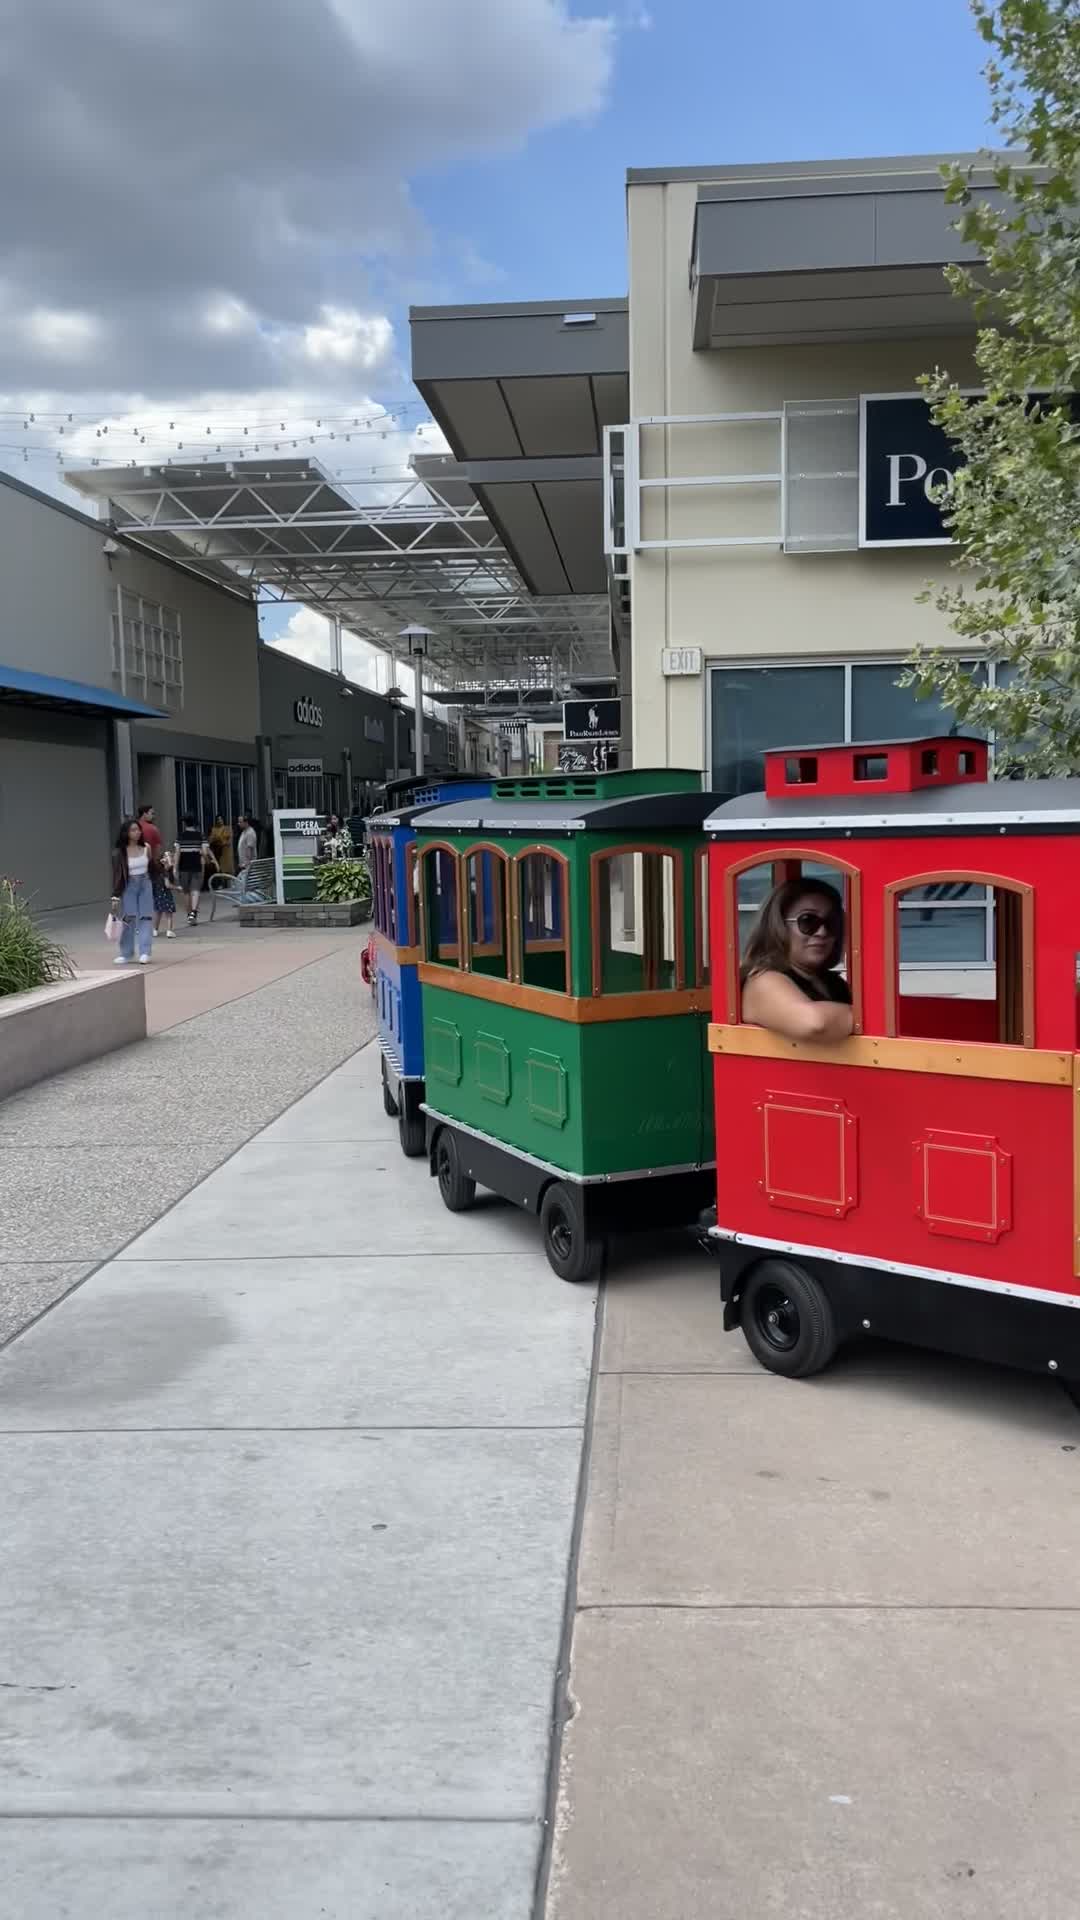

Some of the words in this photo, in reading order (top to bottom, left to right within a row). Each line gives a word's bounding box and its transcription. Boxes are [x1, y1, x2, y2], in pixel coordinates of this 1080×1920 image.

[670, 651, 695, 671] EXIT
[297, 696, 323, 727] adidas
[288, 763, 321, 772] adidas
[295, 820, 320, 830] OPERA
